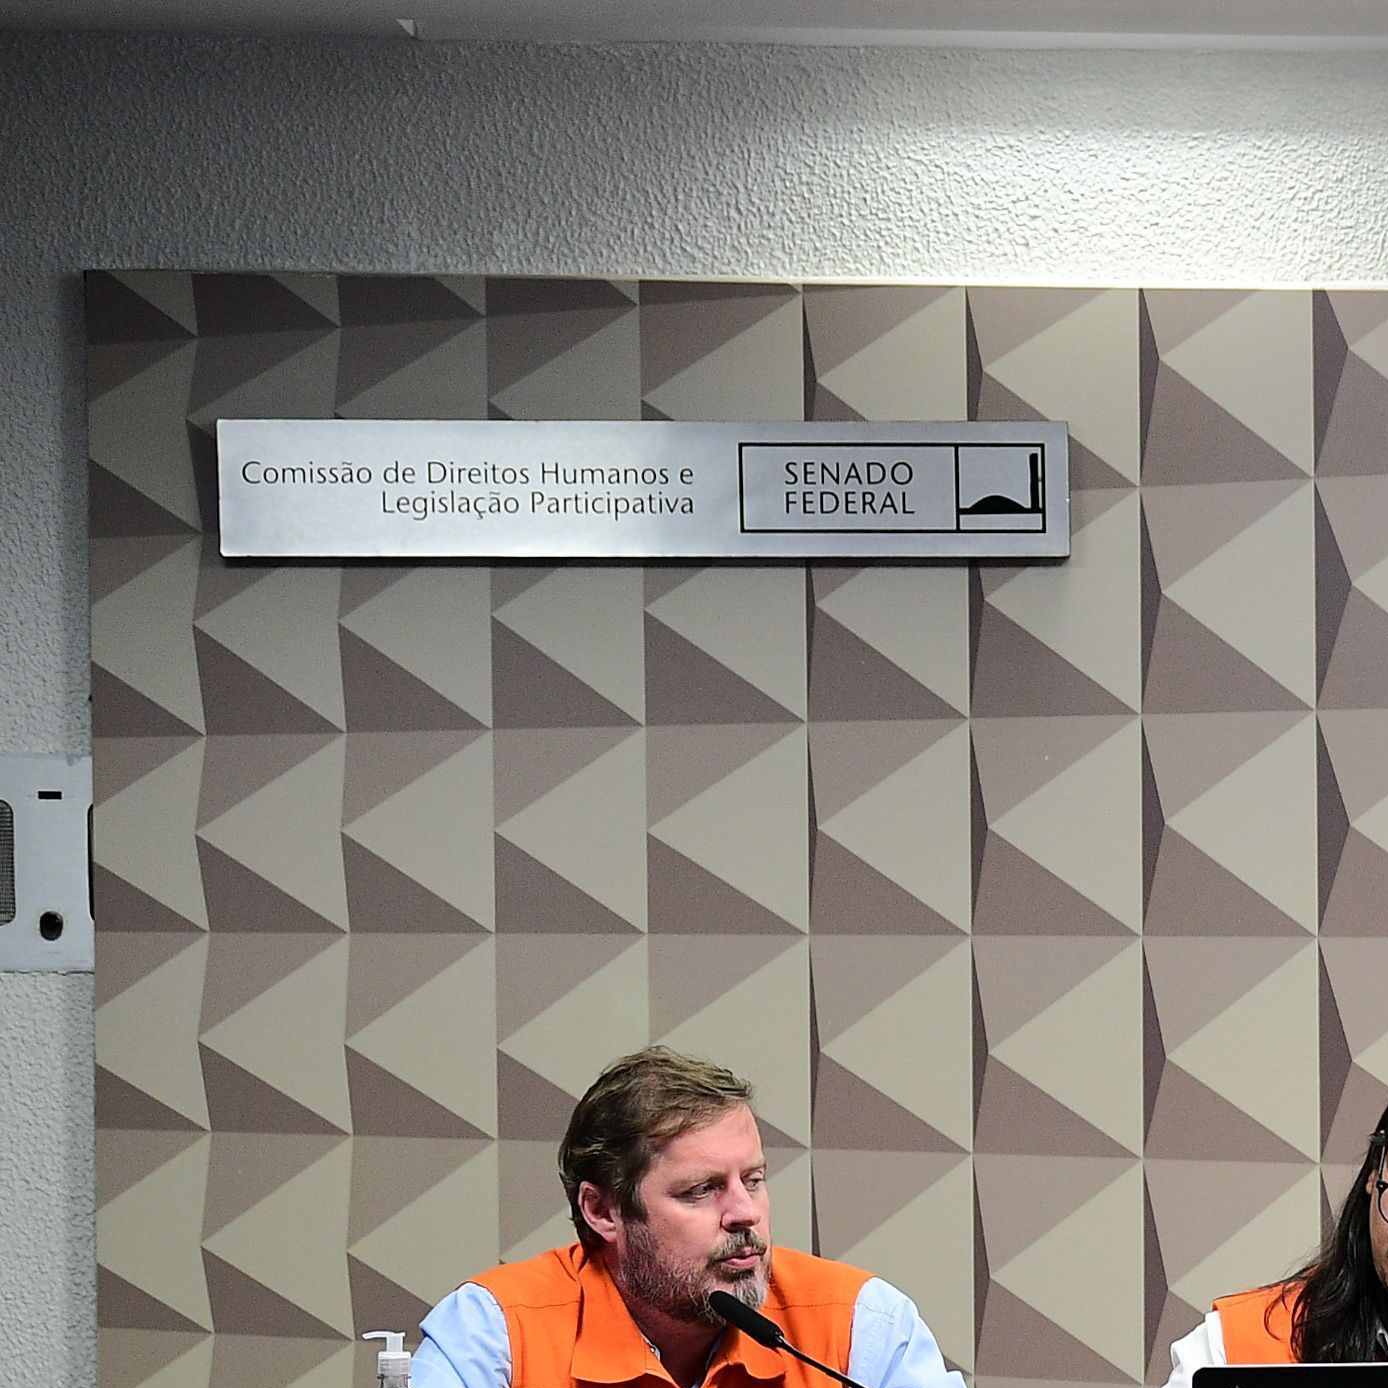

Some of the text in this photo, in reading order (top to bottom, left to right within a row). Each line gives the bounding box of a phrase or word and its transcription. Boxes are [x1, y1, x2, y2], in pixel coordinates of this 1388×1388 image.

[241, 460, 694, 486] Comissão de Direitos Humanos e
[784, 461, 914, 486] SENADO
[382, 489, 695, 522] Legislação Participativa
[785, 490, 916, 515] FEDERAL
